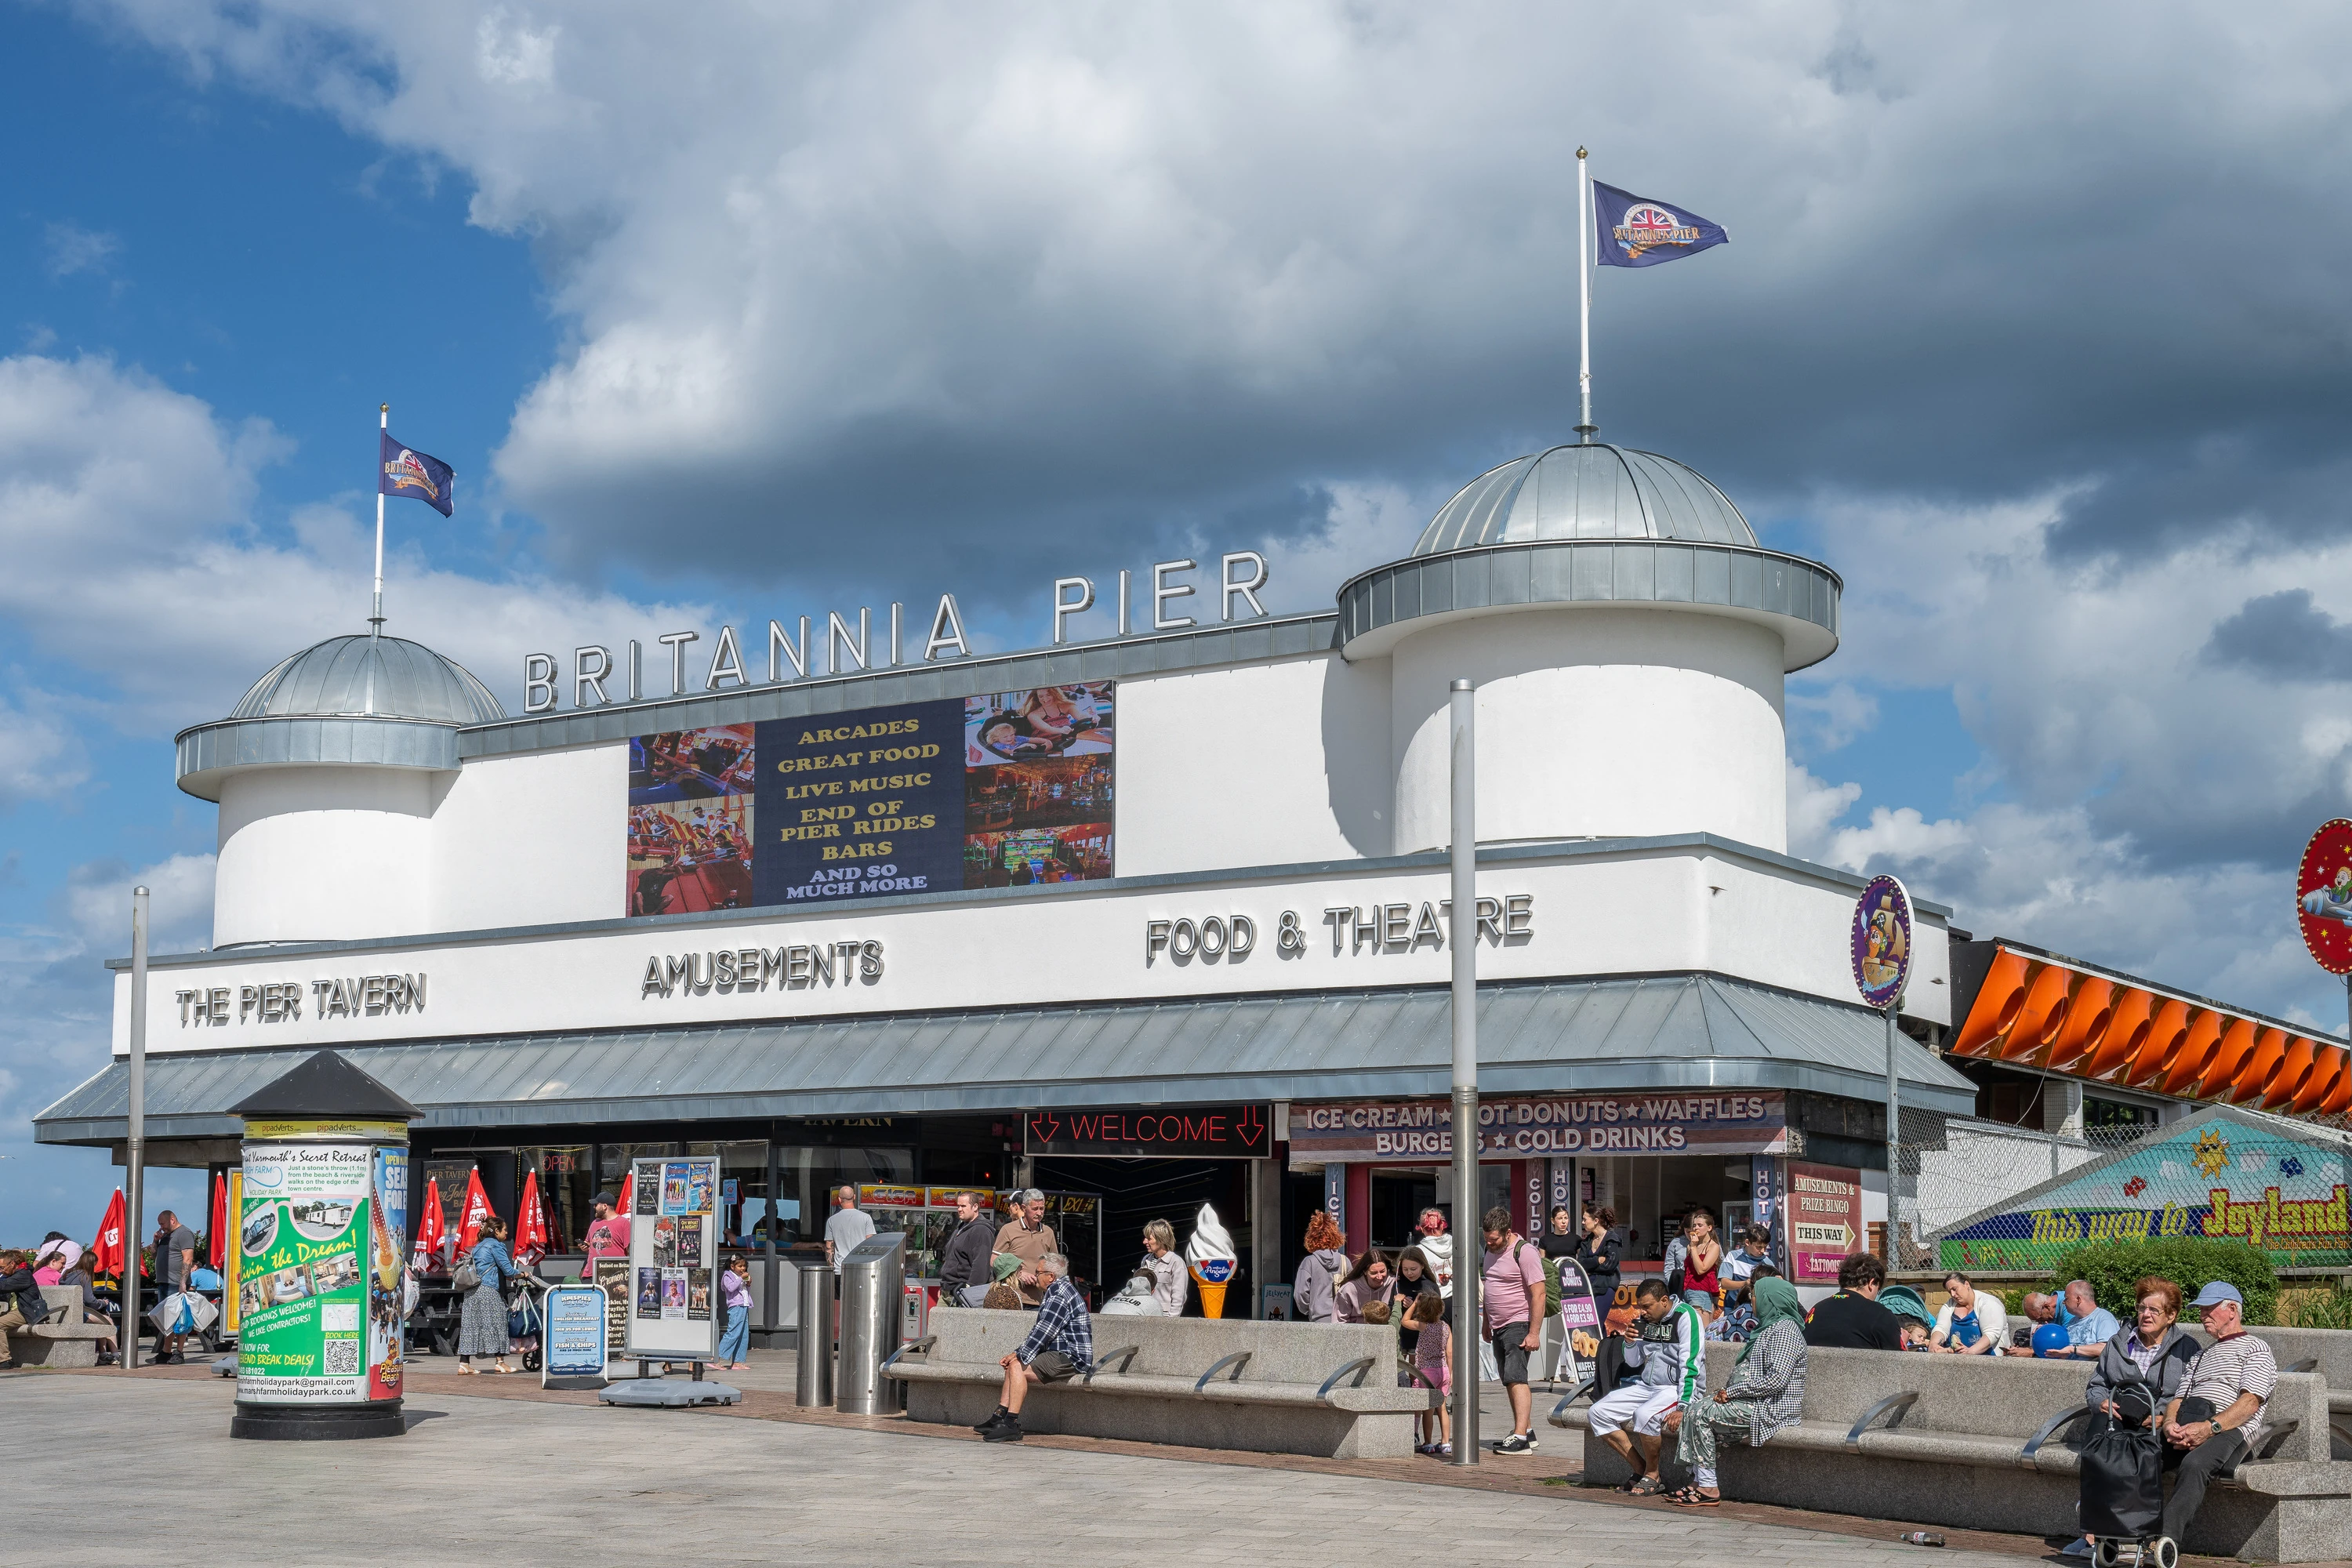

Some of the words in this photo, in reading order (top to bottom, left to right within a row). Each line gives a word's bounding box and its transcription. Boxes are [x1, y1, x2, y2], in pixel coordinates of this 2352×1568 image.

[1674, 227, 1700, 240] PIER
[524, 592, 972, 714] BRITANNIA
[1053, 550, 1269, 645] PIER
[797, 718, 920, 746] ARCADES
[778, 752, 862, 774] GREAT
[869, 743, 941, 765] FOOD
[786, 780, 844, 800] LIVE
[849, 771, 931, 793] MUSIC
[800, 804, 856, 824] END
[868, 799, 904, 817] OF
[780, 822, 842, 842] PIER
[853, 814, 936, 835] RIDES
[822, 841, 893, 862] BARS
[810, 866, 862, 884] AND
[866, 863, 898, 879] SO
[786, 880, 855, 900] MUCH
[858, 875, 927, 893] MORE
[1146, 914, 1258, 960] FOOD
[1277, 909, 1308, 950] &
[641, 939, 884, 993] AMUSEMENTS
[176, 988, 231, 1027] THE
[239, 982, 303, 1022] PIER
[310, 971, 428, 1013] TAVERN
[1306, 1108, 1345, 1130] ICE
[1349, 1105, 1435, 1128] CREAM
[1477, 1104, 1510, 1126] OT
[1517, 1100, 1621, 1125] DONUTS
[1643, 1096, 1767, 1122] WAFFLES
[1070, 1115, 1227, 1142] WELCOME
[1375, 1131, 1484, 1154] BURGES
[1514, 1127, 1582, 1151] COLD
[1589, 1125, 1688, 1150] DRINKS
[252, 1149, 296, 1163] Yarmouth's
[299, 1149, 328, 1163] Secret
[332, 1150, 367, 1163] Retreat
[386, 1155, 399, 1165] OPEN
[543, 1156, 575, 1171] OPEN
[426, 1171, 443, 1179] PIER
[1756, 1170, 1770, 1215] HOT
[1795, 1178, 1847, 1196] AMUSEMENTS
[1848, 1183, 1855, 1196] &
[248, 1197, 260, 1210] YEAR!
[1529, 1178, 1542, 1232] COLD
[1801, 1196, 1824, 1212] PRIZE
[1825, 1199, 1849, 1214] BINGO
[2031, 1207, 2082, 1245] This
[2089, 1210, 2152, 1246] way
[2163, 1200, 2188, 1236] to
[2202, 1185, 2350, 1246] Joyland
[1798, 1227, 1823, 1240] THIS
[1824, 1229, 1843, 1240] WAY
[2266, 1237, 2279, 1250] The
[271, 1247, 293, 1269] the
[296, 1229, 357, 1263] Dream!
[599, 1272, 624, 1287] Cromer
[1204, 1265, 1230, 1278] Angelito
[1562, 1276, 1583, 1287] DONUTS
[1564, 1267, 1576, 1277] HOT
[1120, 1297, 1142, 1307] CLUB
[1612, 1285, 1639, 1306] OT
[250, 1311, 278, 1327] BOOKINGS
[278, 1299, 317, 1316] WELCOME!
[1564, 1305, 1568, 1314] 6
[1568, 1304, 1578, 1313] FOR
[1578, 1303, 1592, 1313] £4.90
[1566, 1315, 1570, 1323] 4
[1570, 1314, 1580, 1323] FOR
[1580, 1312, 1595, 1323] £3.90
[248, 1330, 256, 1338] WE
[256, 1327, 266, 1338] LIKE
[267, 1313, 311, 1332] CONTRACTORS!
[245, 1344, 256, 1352] NOW
[257, 1343, 270, 1352] FOR
[257, 1355, 281, 1365] BREAK
[284, 1355, 314, 1366] DEALS!
[379, 1363, 403, 1374] Pleasure
[380, 1372, 400, 1382] Beach
